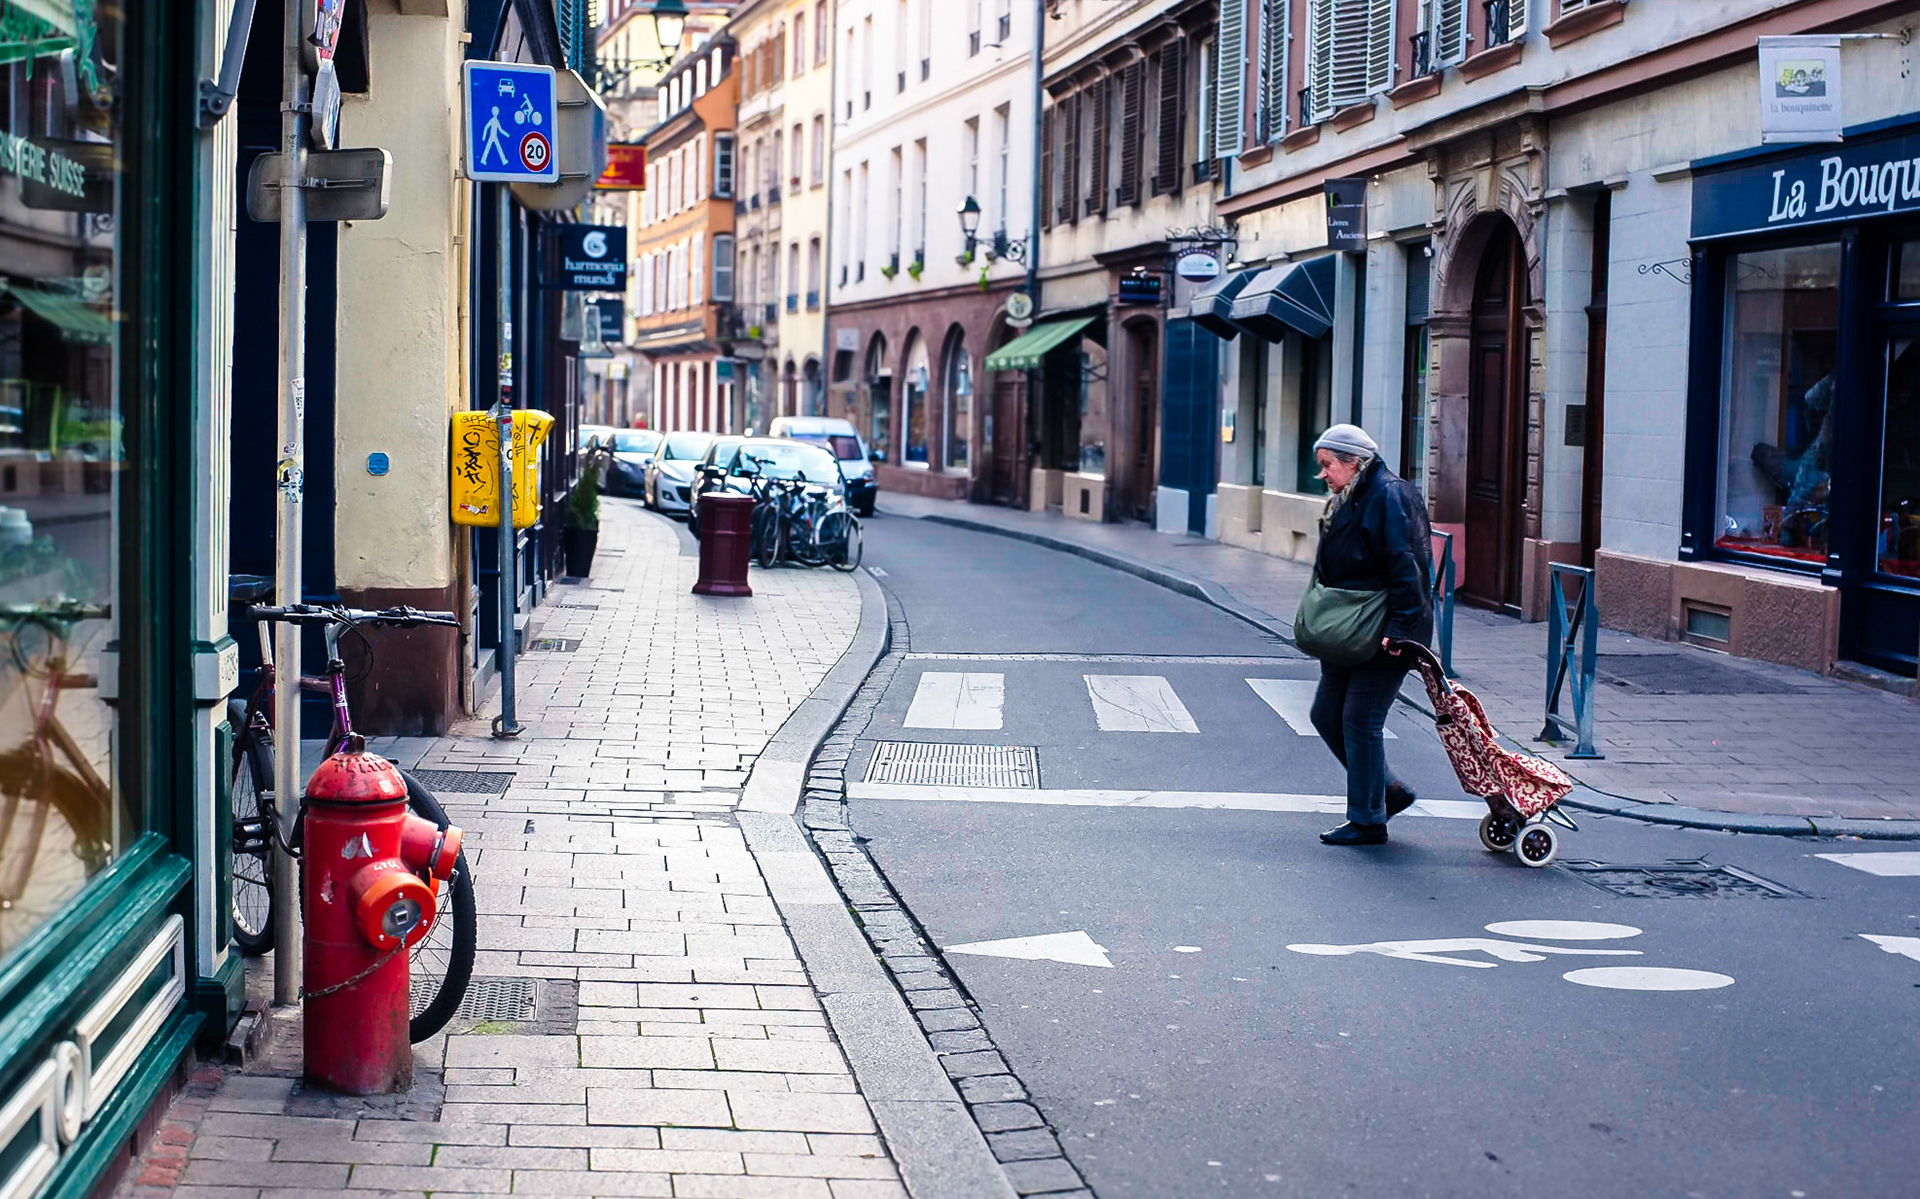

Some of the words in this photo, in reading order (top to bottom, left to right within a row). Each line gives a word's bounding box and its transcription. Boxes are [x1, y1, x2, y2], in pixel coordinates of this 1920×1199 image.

[526, 144, 545, 160] 20
[49, 151, 86, 198] SUISSE
[1767, 169, 1807, 223] La
[1814, 155, 1920, 212] Bouqu
[1327, 216, 1349, 227] Livres
[573, 270, 617, 286] mundi
